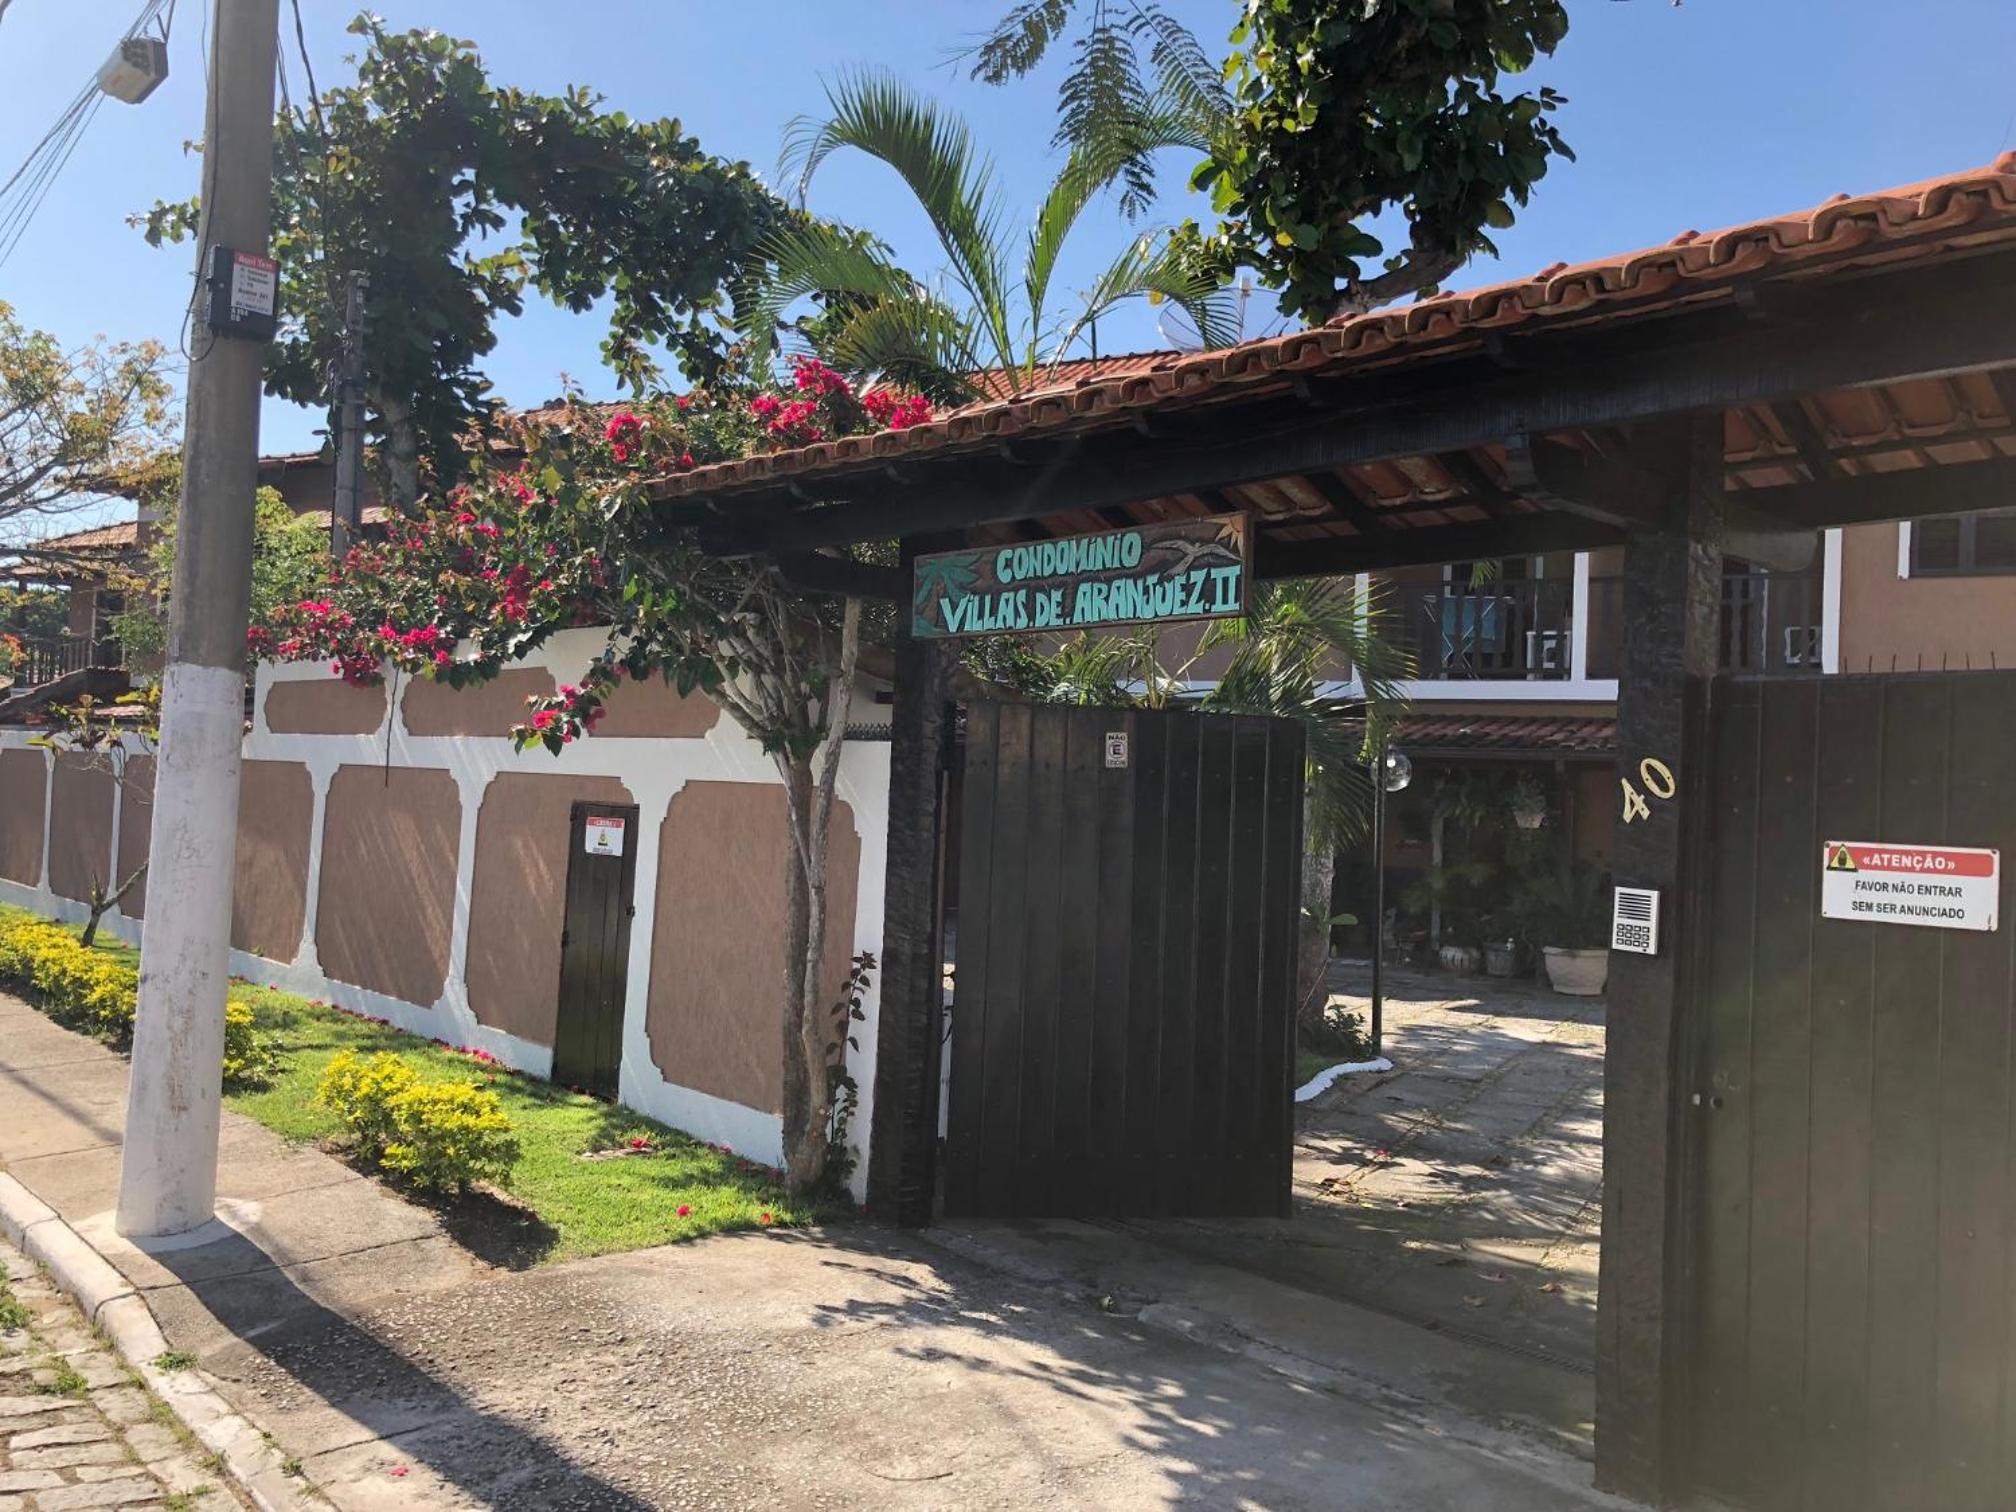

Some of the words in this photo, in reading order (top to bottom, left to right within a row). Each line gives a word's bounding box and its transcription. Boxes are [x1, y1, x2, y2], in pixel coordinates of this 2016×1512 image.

[1621, 757, 1676, 824] 40
[1855, 880, 1889, 893] FAVOR
[1892, 881, 1915, 895] NÃO
[1917, 884, 1963, 898] ENTRAR
[1852, 901, 1873, 912] SEM
[1876, 902, 1897, 914] SER
[1900, 905, 1965, 919] ANUNCIADO
